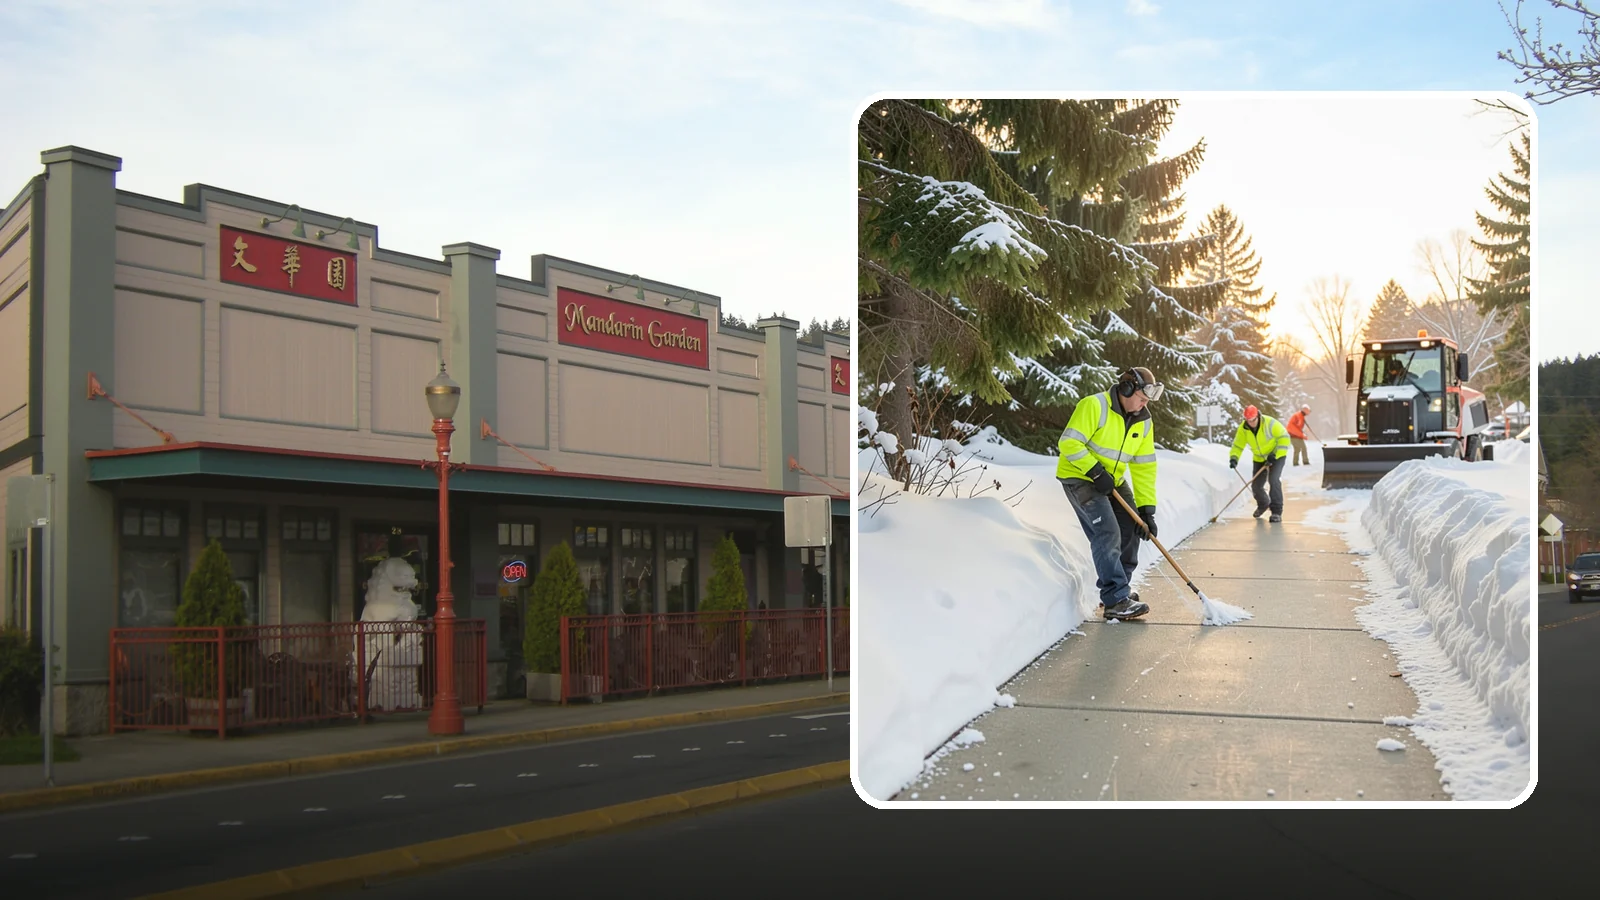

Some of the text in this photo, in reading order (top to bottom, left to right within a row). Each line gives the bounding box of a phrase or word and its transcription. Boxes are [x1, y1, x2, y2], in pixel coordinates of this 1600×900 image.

[230, 235, 347, 291] 文華園
[564, 302, 702, 352] Mandarin Garden
[503, 565, 527, 578] OPEN
